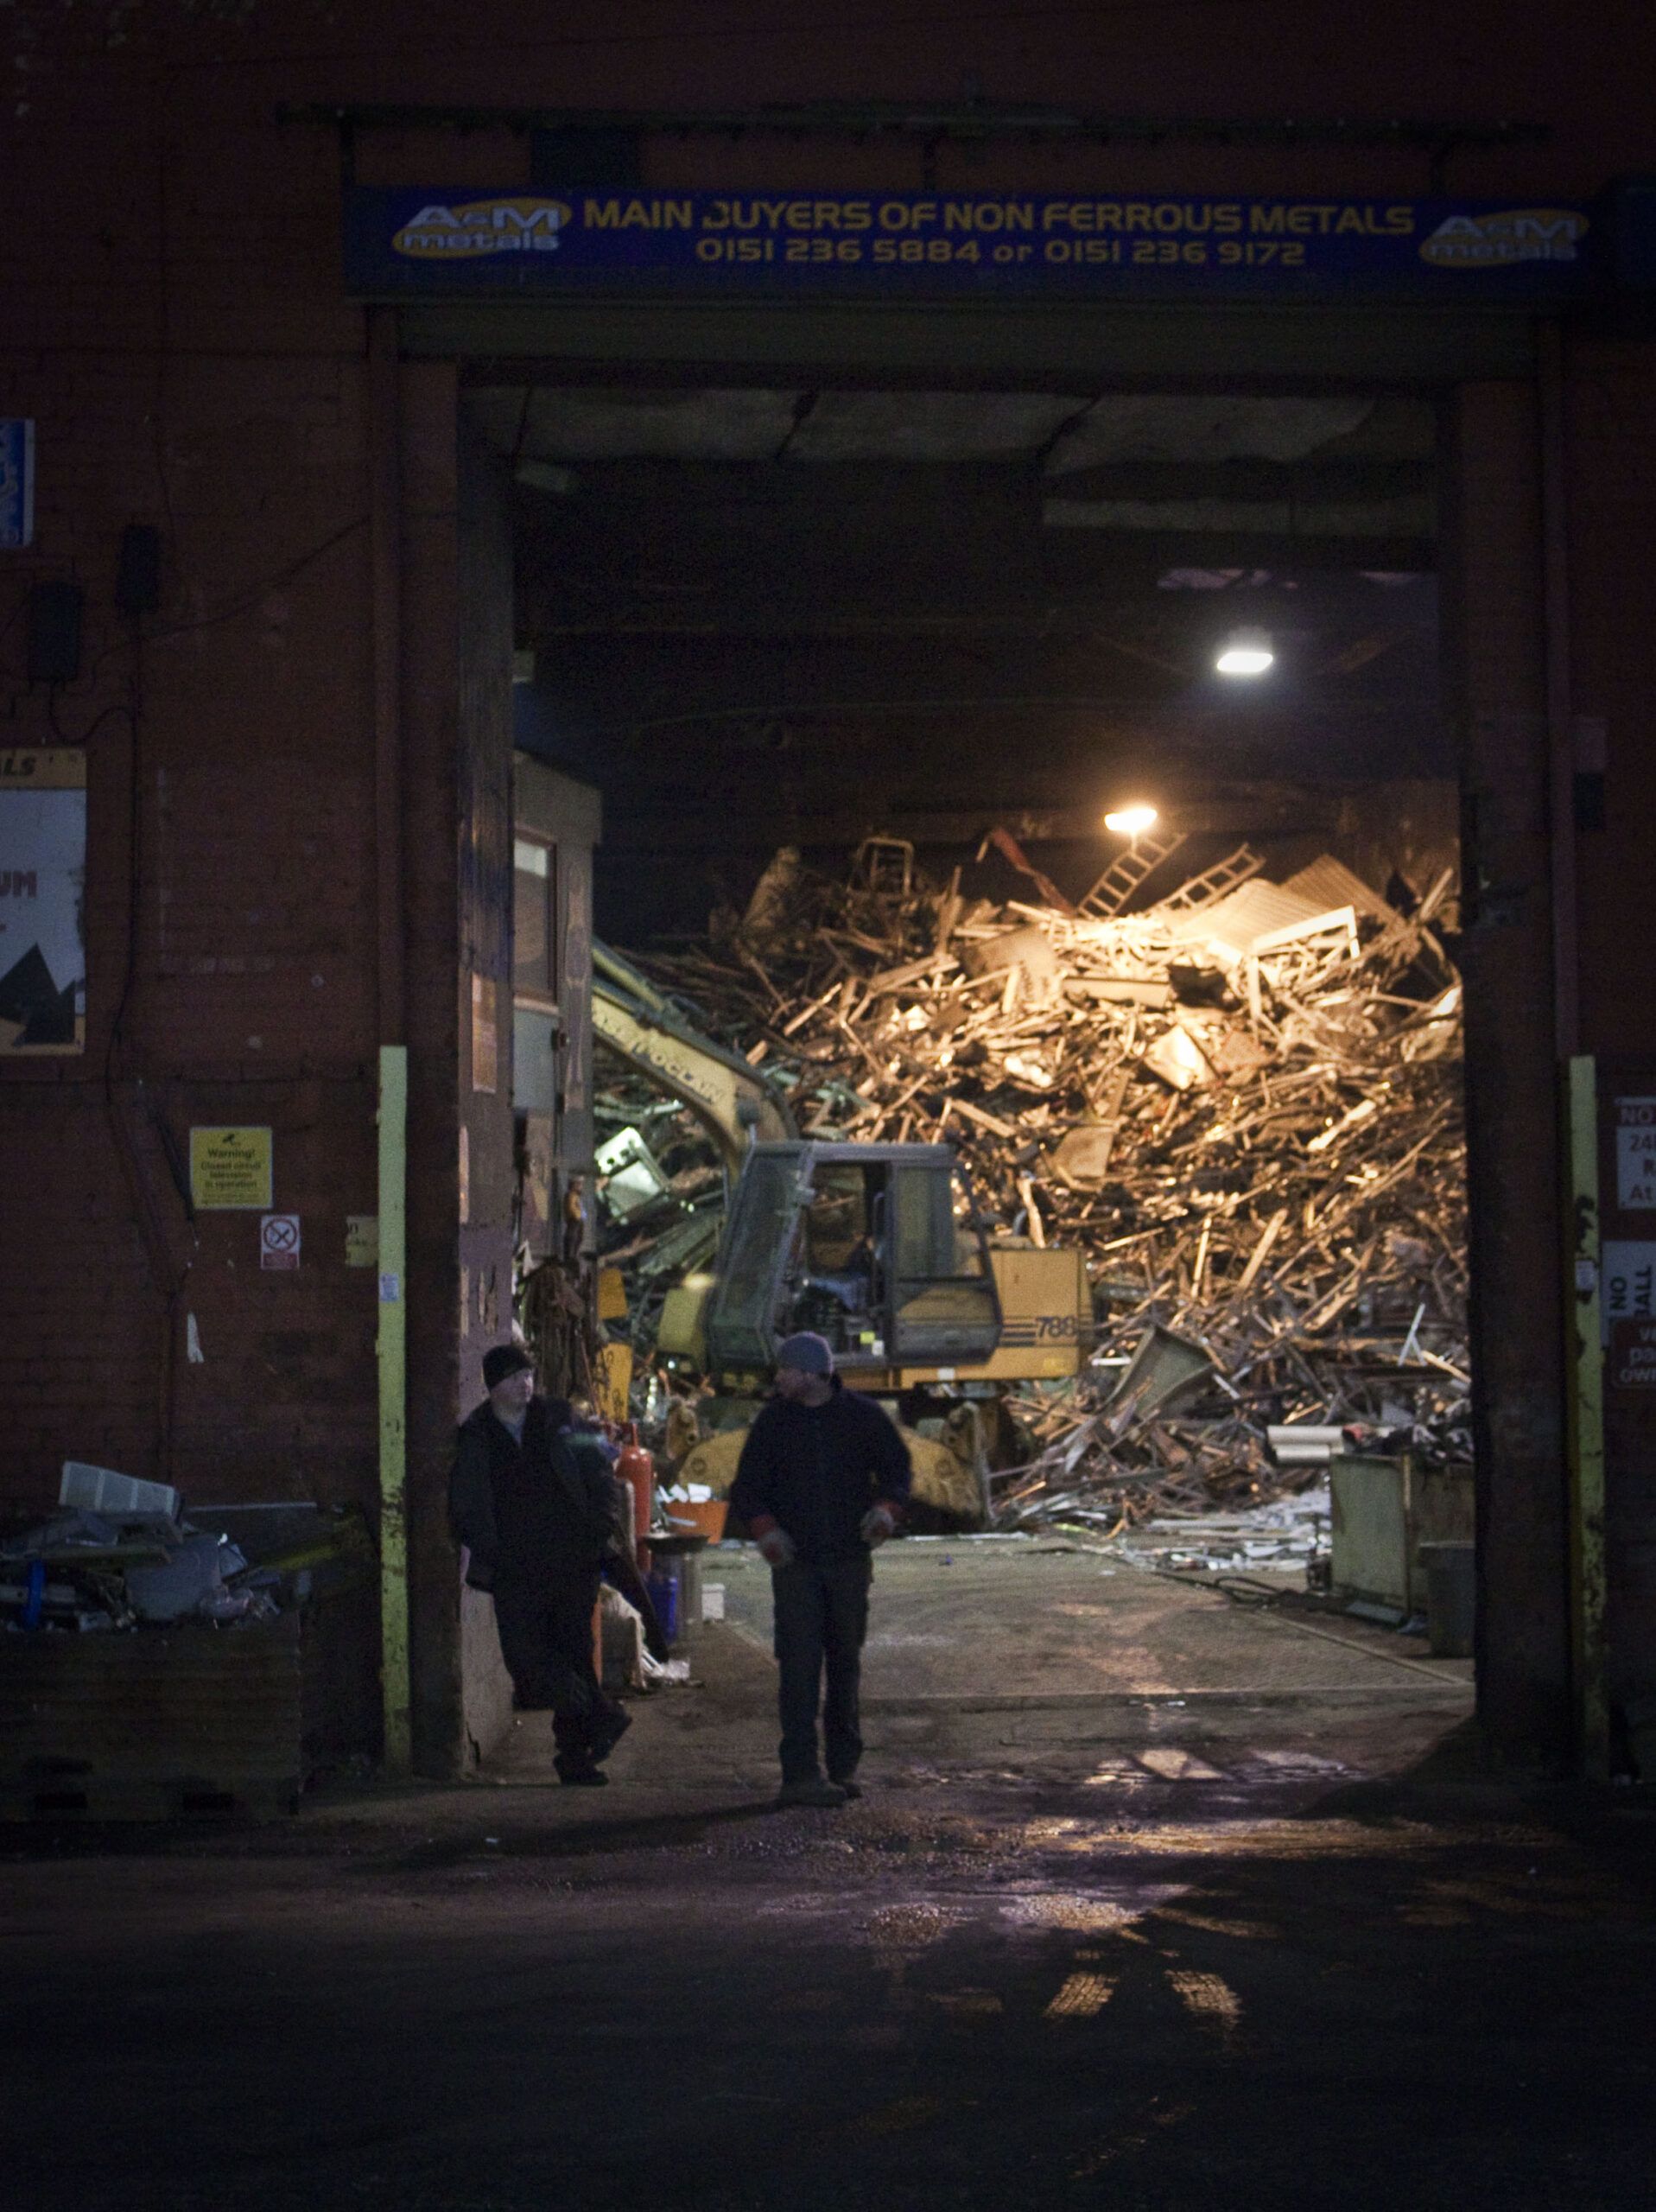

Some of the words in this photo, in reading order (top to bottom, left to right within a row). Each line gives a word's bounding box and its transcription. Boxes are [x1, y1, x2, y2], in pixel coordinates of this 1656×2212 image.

[583, 199, 693, 229] MAIN
[878, 201, 938, 232] OF
[944, 202, 1034, 232] NON
[1042, 203, 1242, 234] FERROUS
[1249, 205, 1416, 235] METALS
[403, 226, 560, 251] metals
[1430, 238, 1578, 262] metals
[695, 238, 774, 263] 0151
[784, 238, 862, 263] 236
[872, 238, 981, 264] 5884
[993, 243, 1033, 264] or
[1044, 239, 1120, 264] 0151
[1132, 240, 1207, 264] 236
[1217, 240, 1306, 266] 9172
[1620, 1105, 1652, 1125] NO
[1610, 1276, 1627, 1310] NO
[1035, 1316, 1077, 1338] 788
